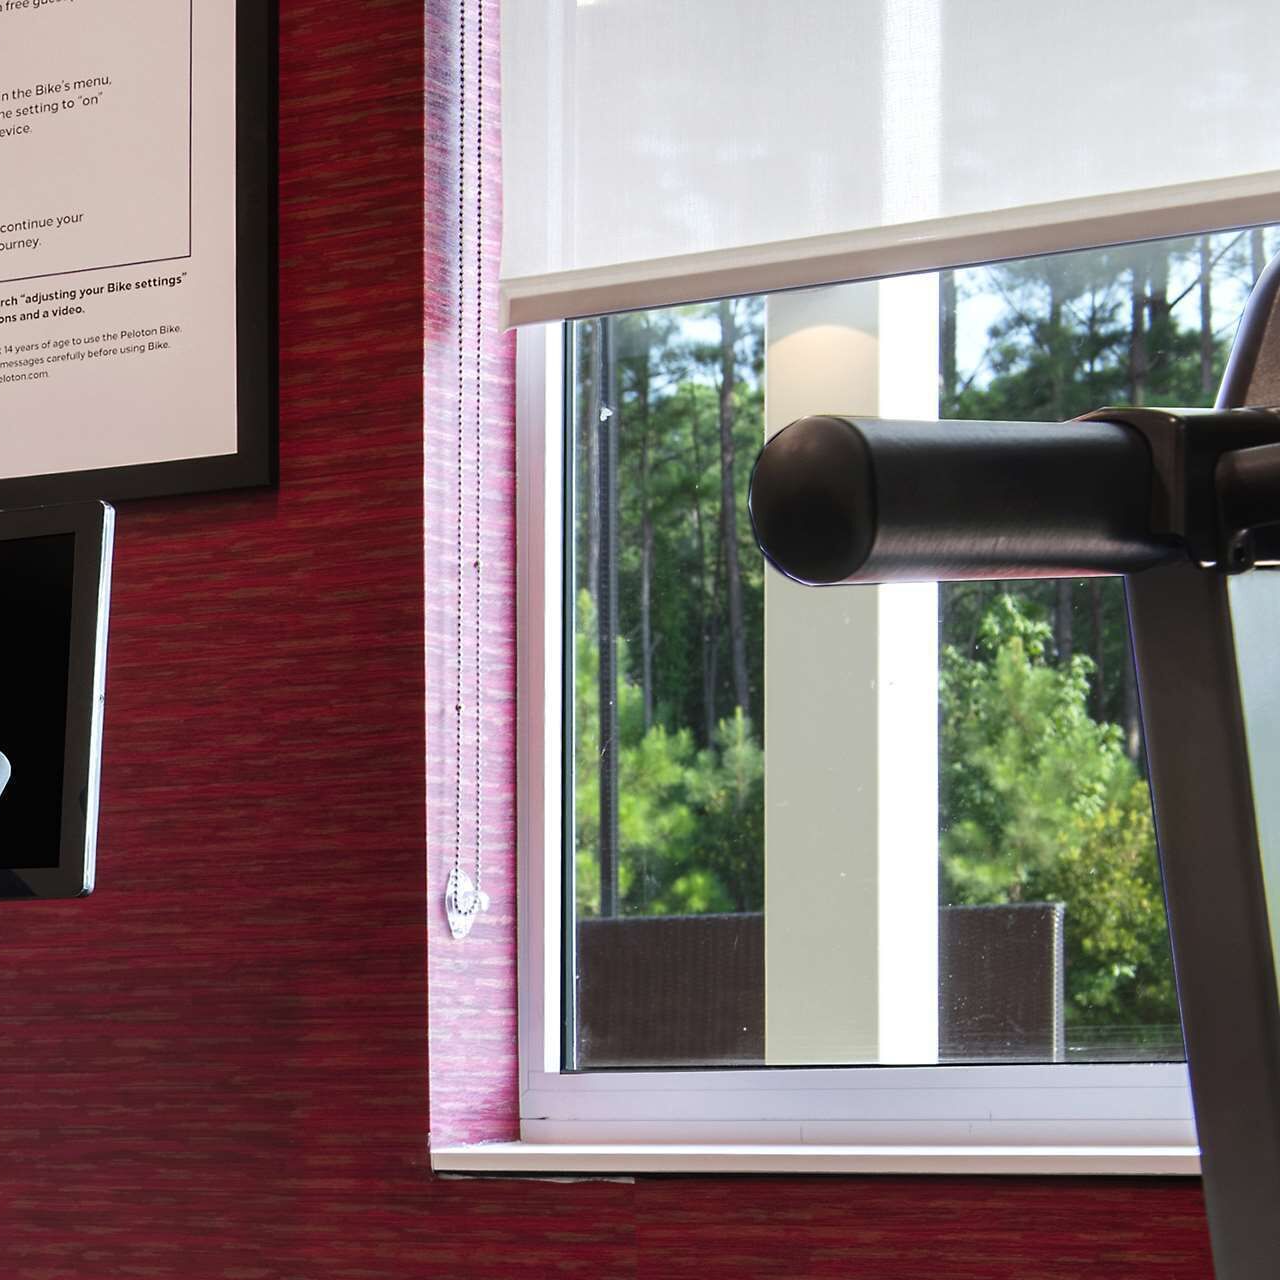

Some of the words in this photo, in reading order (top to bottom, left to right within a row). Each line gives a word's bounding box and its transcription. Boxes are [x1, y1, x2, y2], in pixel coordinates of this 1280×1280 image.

[5, 0, 30, 11] free
[15, 102, 59, 116] setting
[0, 218, 54, 233] continue
[56, 213, 84, 228] your
[79, 286, 105, 299] your
[107, 281, 132, 292] Bike
[19, 308, 40, 320] and
